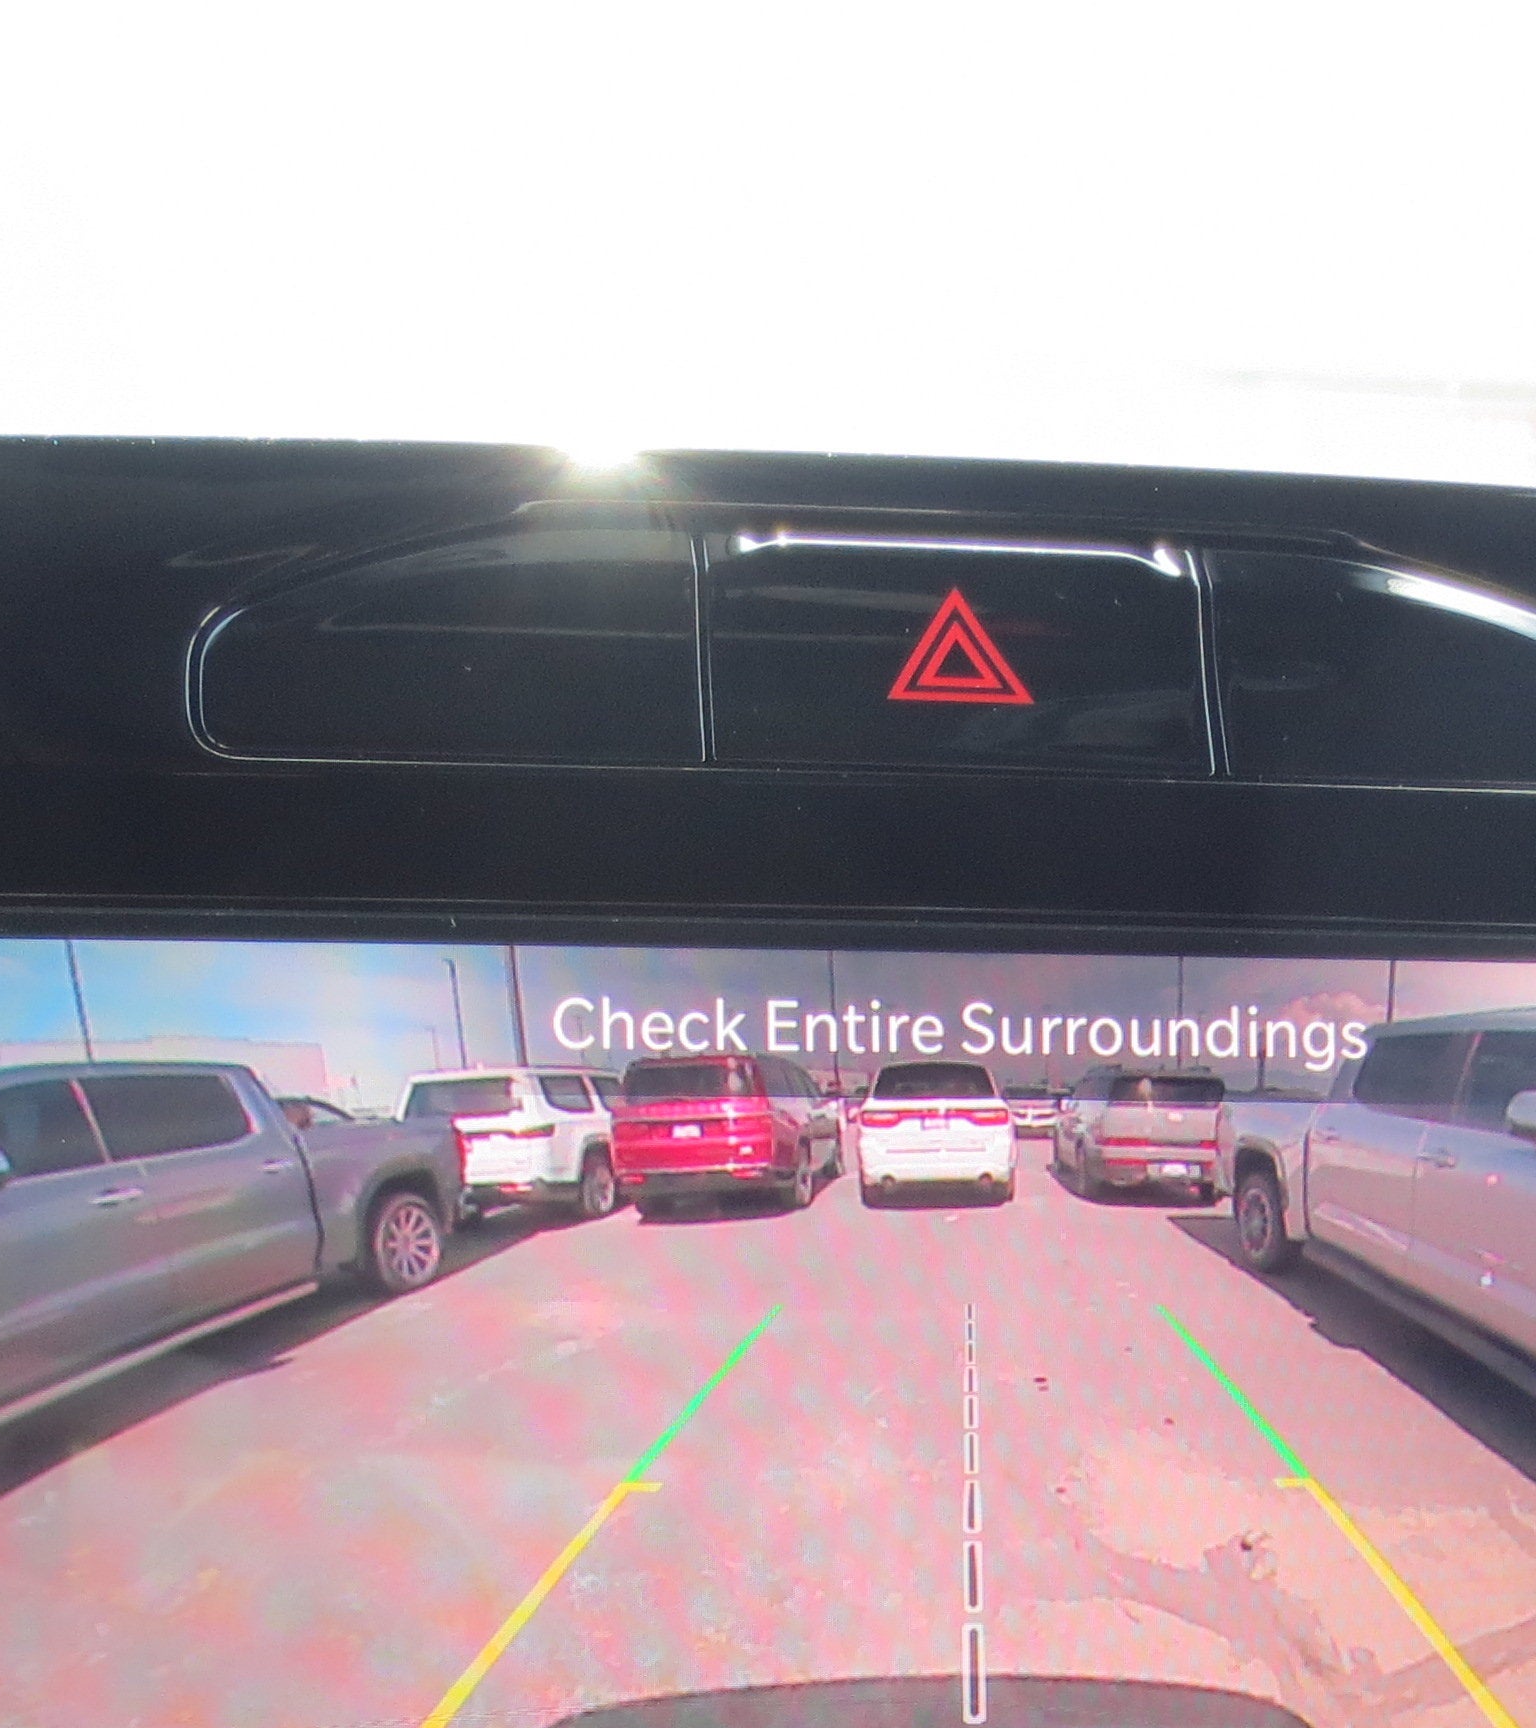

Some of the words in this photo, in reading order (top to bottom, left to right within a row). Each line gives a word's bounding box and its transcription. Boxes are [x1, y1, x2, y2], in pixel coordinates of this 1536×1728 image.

[553, 996, 748, 1051] Check
[766, 999, 945, 1054] Entire
[961, 1001, 1368, 1072] Surroundings
